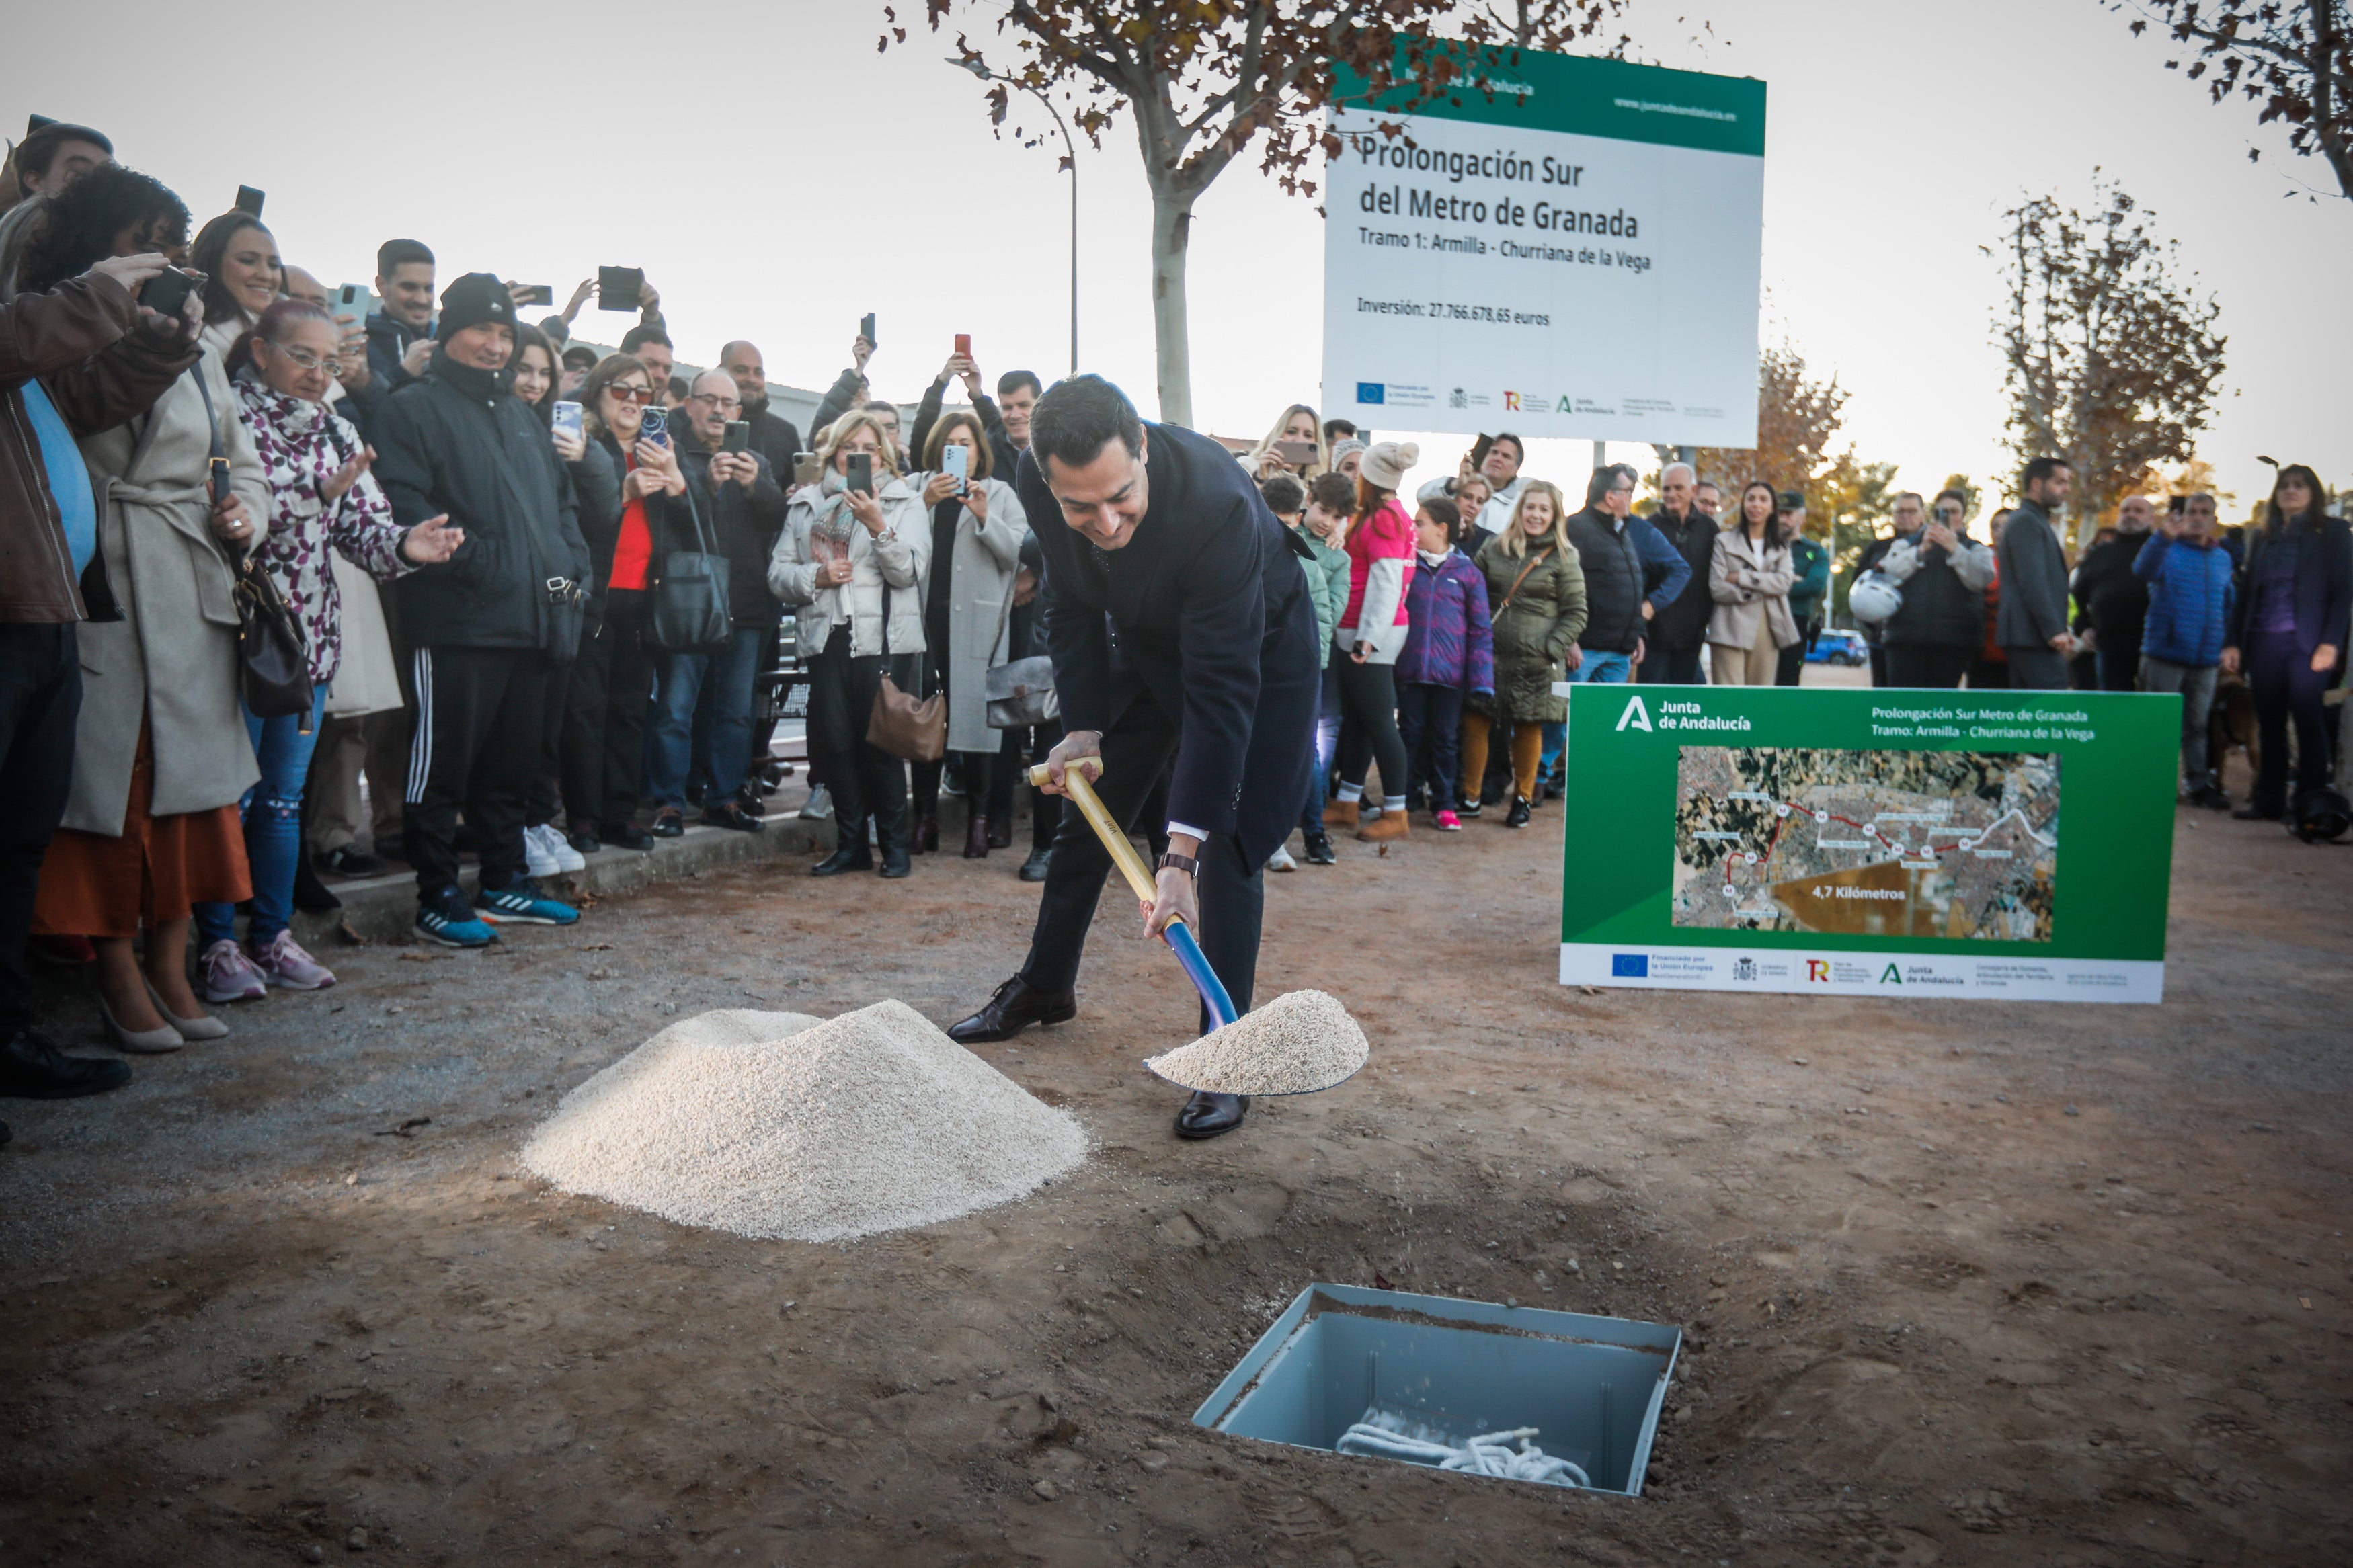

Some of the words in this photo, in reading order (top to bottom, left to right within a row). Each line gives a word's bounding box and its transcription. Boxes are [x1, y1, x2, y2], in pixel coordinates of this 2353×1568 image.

[1362, 136, 1533, 183] Prolongación
[1542, 156, 1583, 187] Sur
[1360, 183, 1400, 215] del
[1410, 188, 1487, 224] Metro
[1495, 196, 1525, 227] de
[1533, 202, 1638, 239] Granada
[1359, 227, 1410, 248] Tramo
[1414, 232, 1427, 249] 1:
[1431, 234, 1486, 255] Armilla
[1500, 240, 1574, 263] Churriana
[1578, 247, 1595, 265] de
[1599, 249, 1612, 267] la
[1616, 250, 1651, 274] Vega
[1357, 297, 1425, 317] Inversión:
[1429, 302, 1511, 324] 27.766.678,65
[1513, 311, 1550, 327] euros
[1659, 700, 1701, 714] Junta
[1872, 707, 1952, 723] Prolongación
[1955, 708, 1977, 721] Sur
[1979, 708, 2015, 722] Metro
[2017, 709, 2033, 722] de
[2035, 709, 2089, 723] Granada
[1659, 715, 1677, 729] de
[1679, 714, 1751, 731] Andalucía
[1871, 724, 1914, 737] Tramo:
[1916, 725, 1960, 738] Armilla
[1969, 726, 2031, 739] Churriana
[2032, 727, 2049, 739] de
[2051, 727, 2063, 739] la
[2065, 727, 2096, 743] Vega
[1103, 820, 1118, 835] VIAT
[1812, 886, 1833, 900] 4,7
[1835, 885, 1906, 901] Kilómetros
[1683, 964, 1714, 972] Europea
[1907, 966, 1933, 975] Junta
[1907, 975, 1917, 984] de
[1919, 976, 1964, 985] Andalucía
